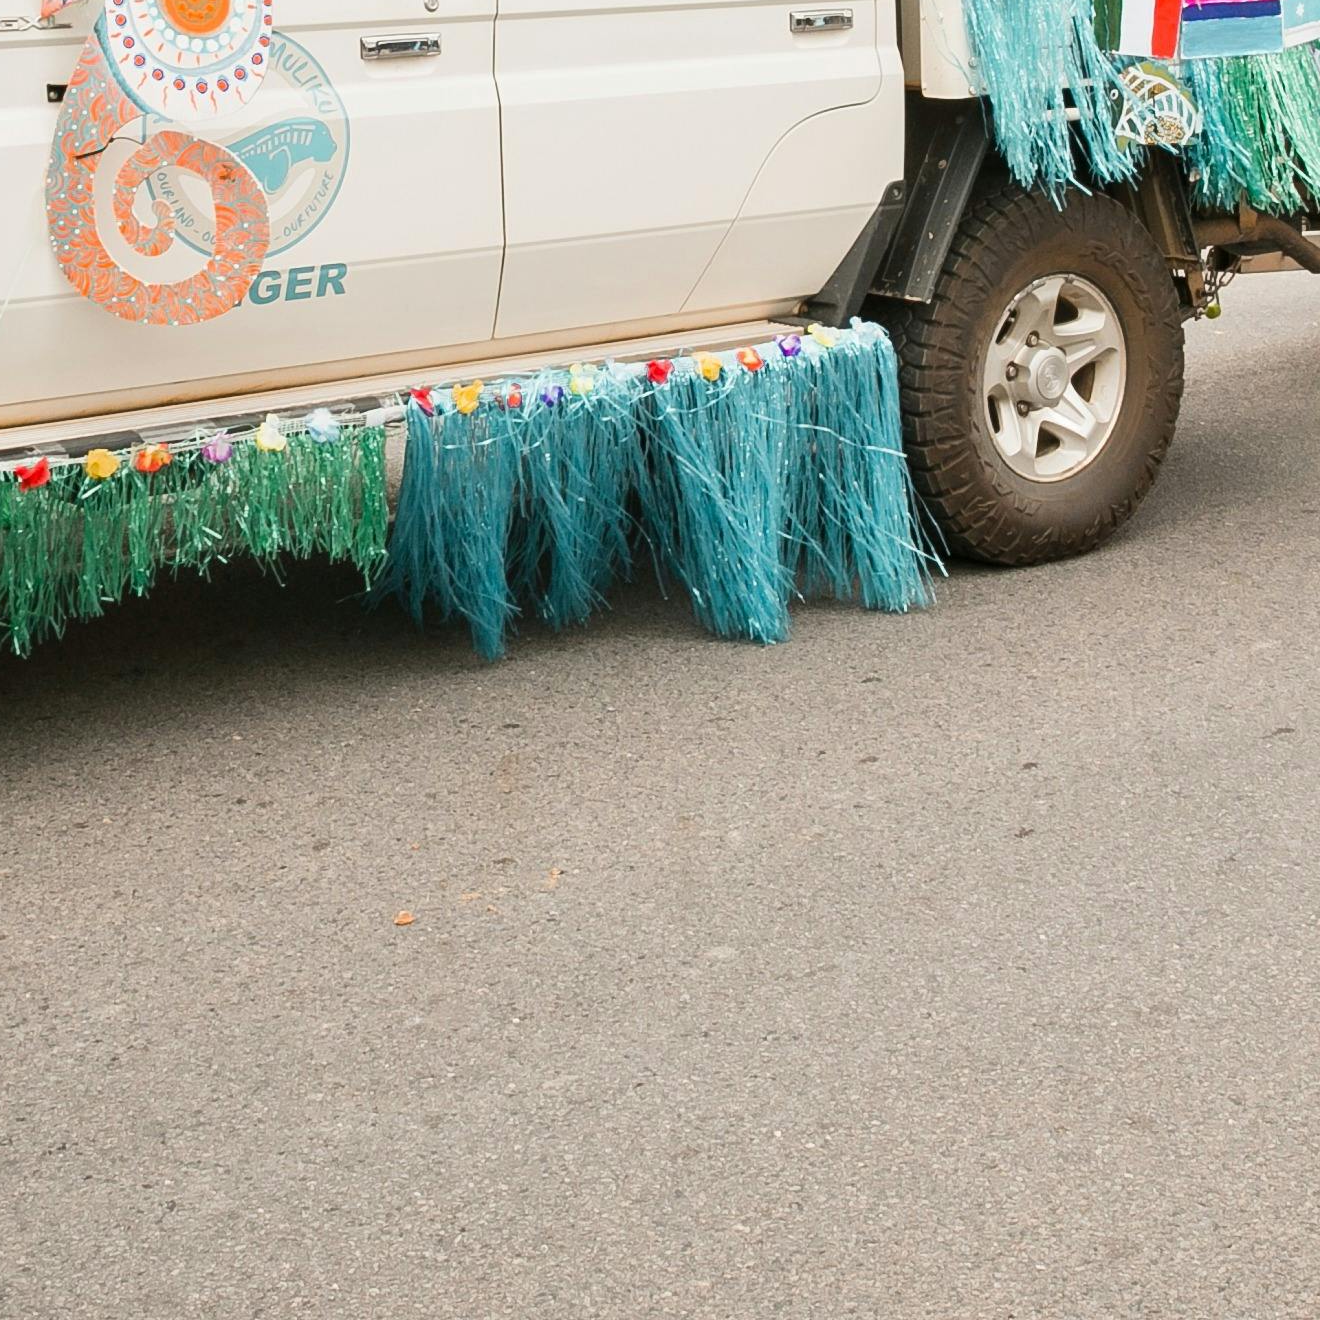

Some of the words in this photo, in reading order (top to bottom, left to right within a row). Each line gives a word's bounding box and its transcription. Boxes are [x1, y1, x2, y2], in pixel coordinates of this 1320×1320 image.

[157, 172, 175, 200] OUR
[282, 213, 307, 237] OUR
[304, 170, 334, 217] FUTURE
[246, 263, 348, 306] GER
